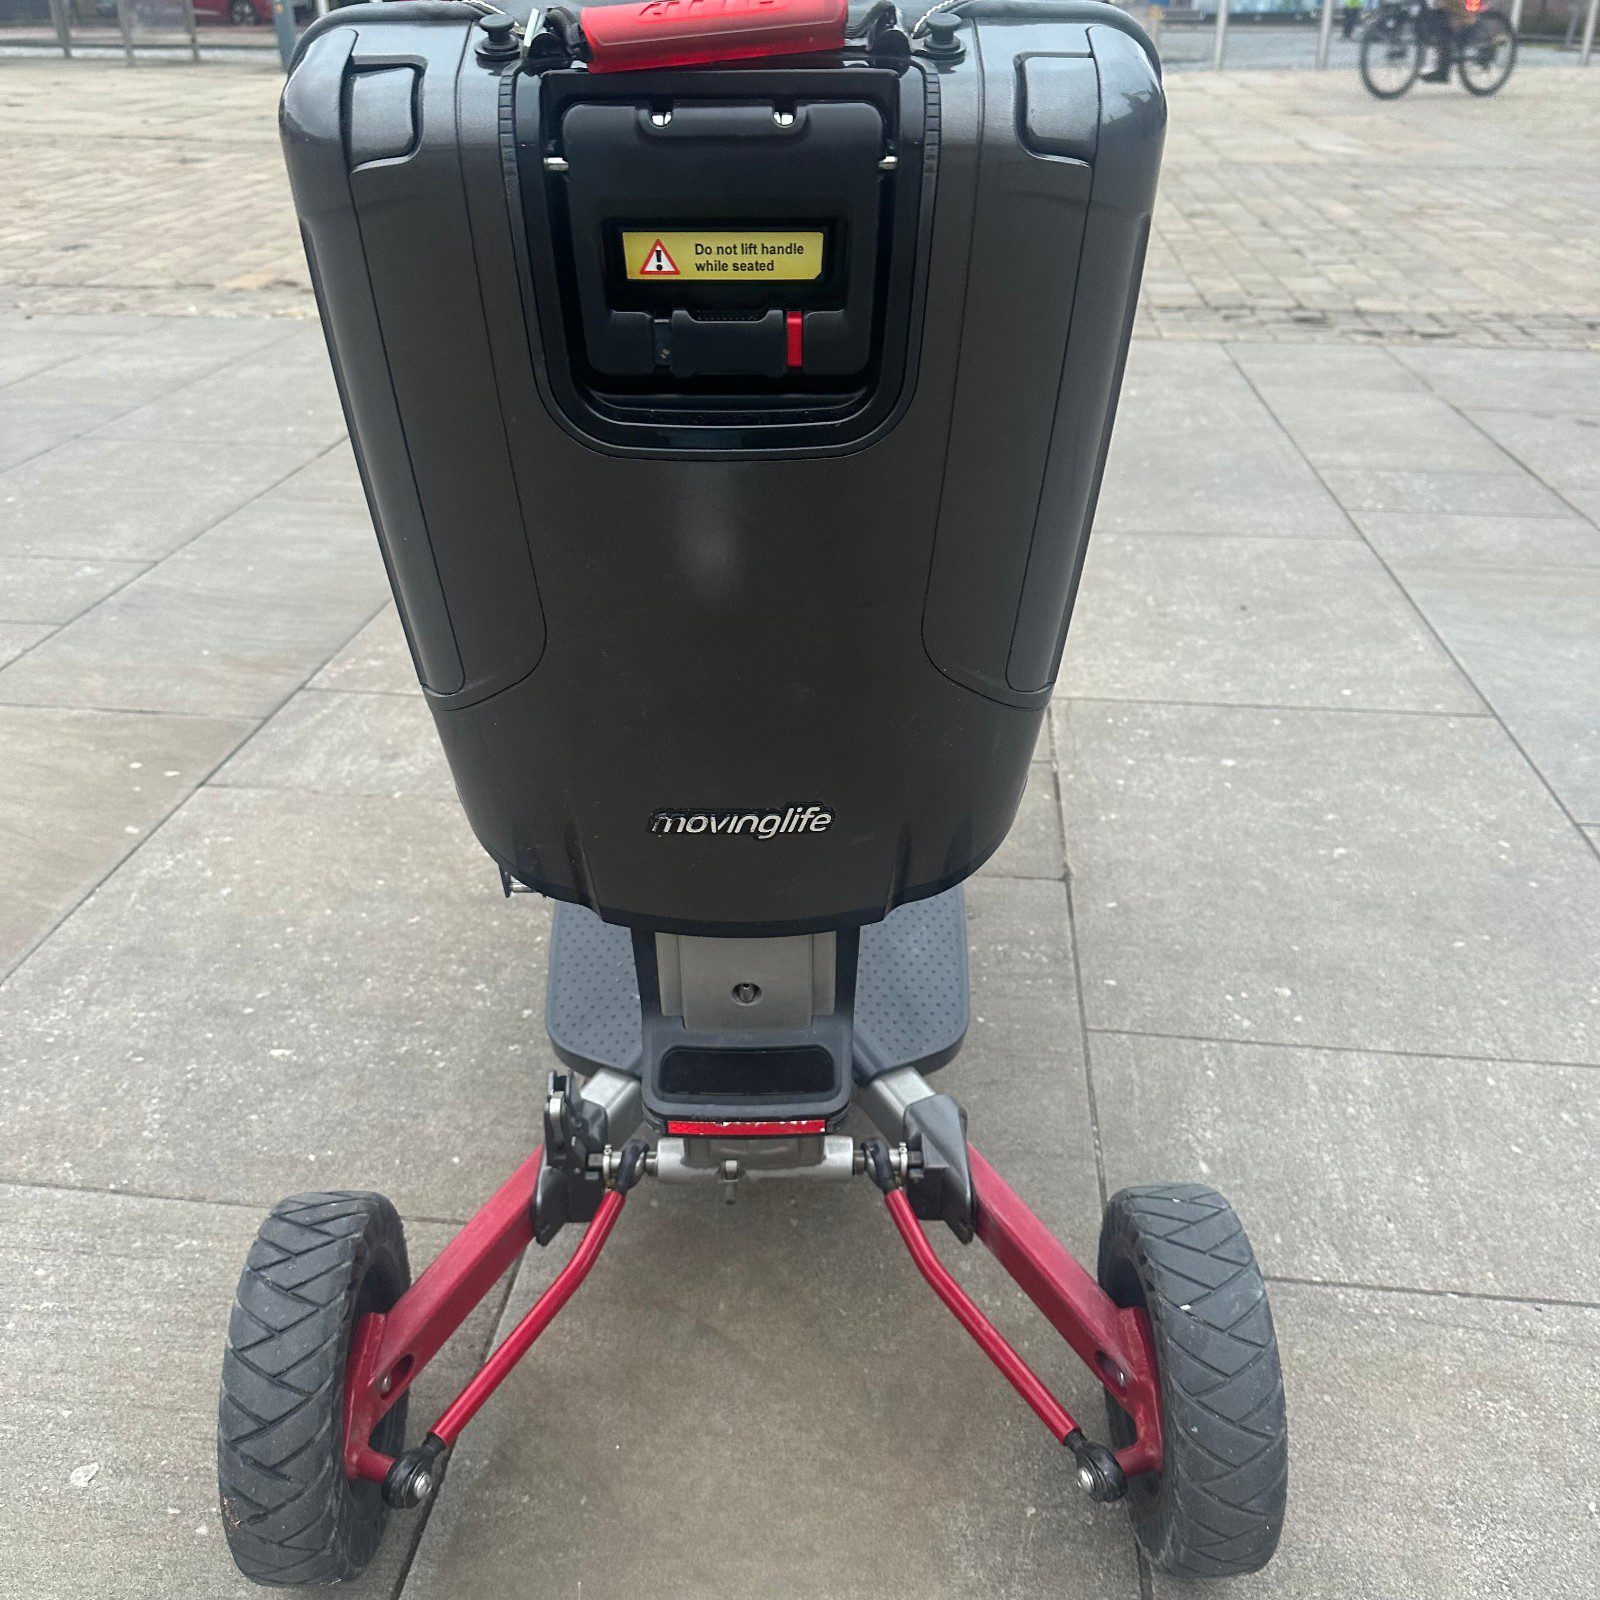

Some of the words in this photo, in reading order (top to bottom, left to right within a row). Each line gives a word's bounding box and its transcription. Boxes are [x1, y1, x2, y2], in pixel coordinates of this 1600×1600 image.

[694, 243, 713, 256] Do
[716, 244, 737, 255] not
[740, 243, 758, 255] lift
[761, 243, 804, 255] handle
[695, 260, 729, 272] while
[732, 260, 775, 272] seated
[651, 806, 832, 839] movinglife
